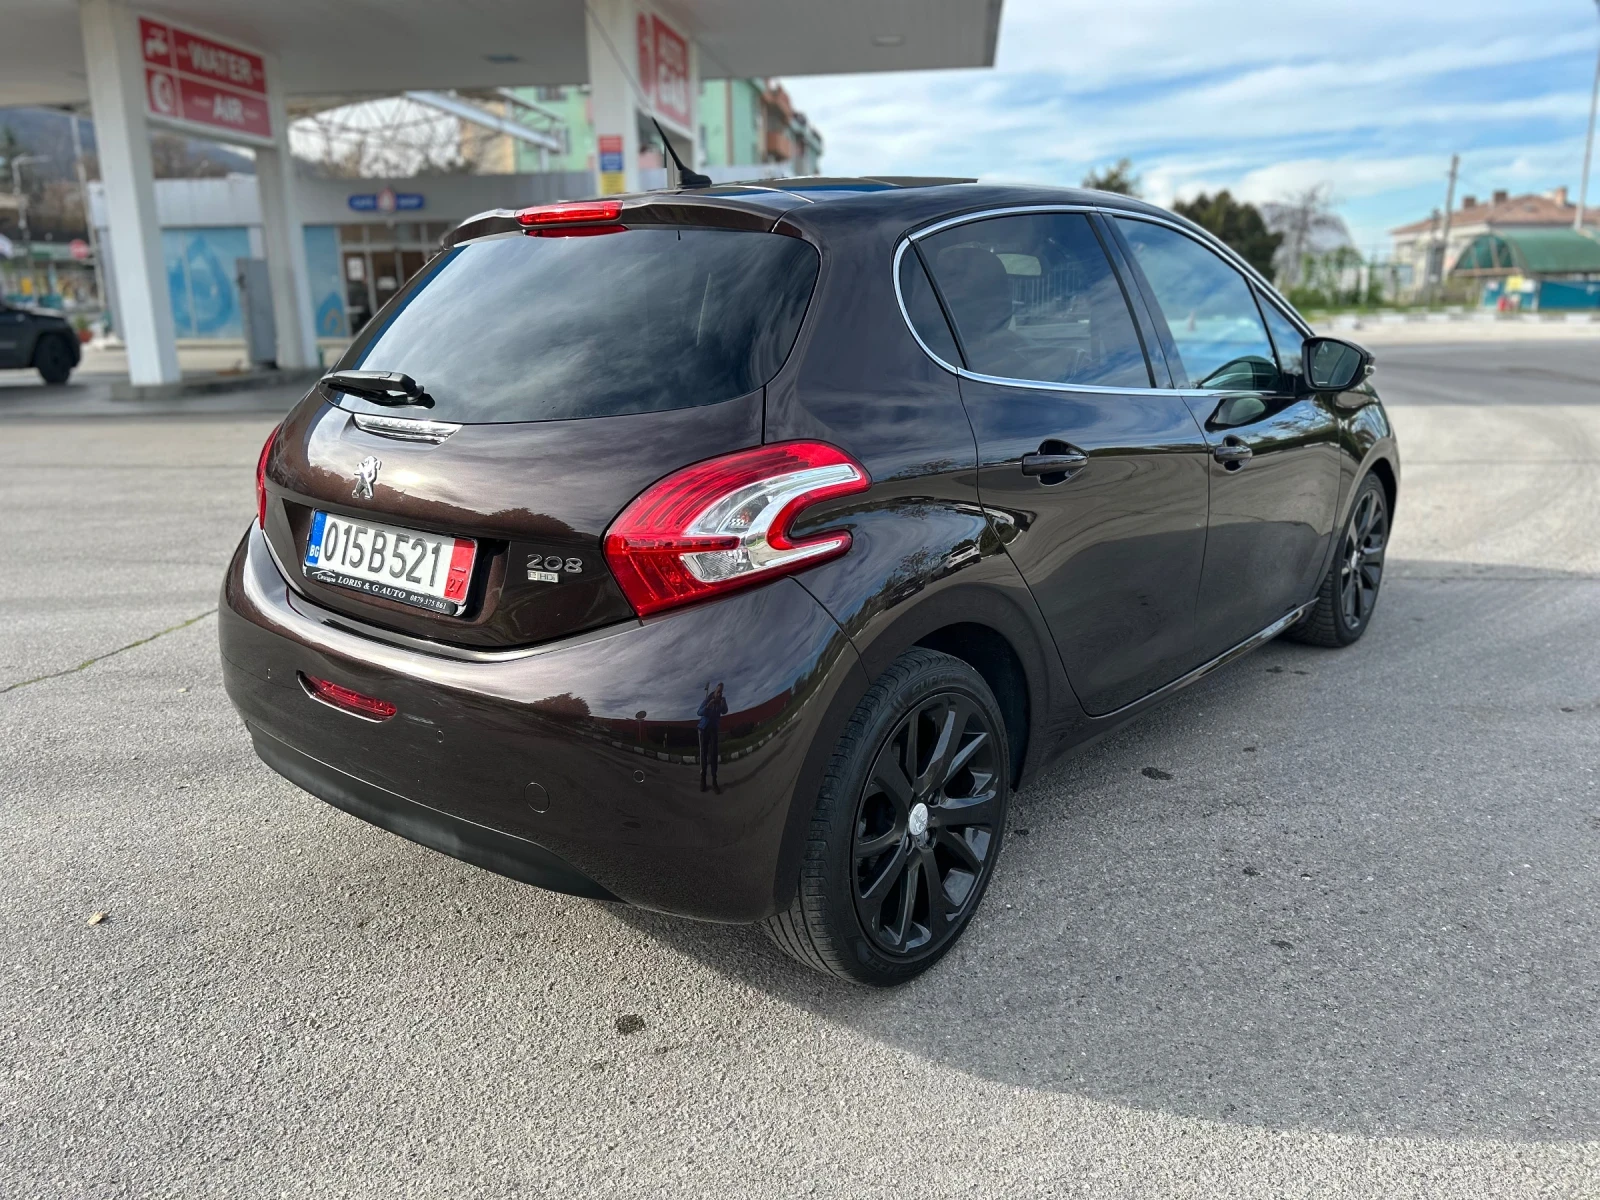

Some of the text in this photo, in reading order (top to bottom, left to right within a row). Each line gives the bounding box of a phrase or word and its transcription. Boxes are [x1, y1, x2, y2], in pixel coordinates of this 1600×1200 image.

[187, 40, 254, 85] WATER
[213, 93, 245, 123] AIR
[309, 545, 320, 558] BG
[324, 521, 442, 587] 015B521
[526, 554, 583, 573] 208
[337, 576, 363, 588] LORIS
[363, 582, 371, 591] &
[372, 584, 380, 593] G
[380, 586, 406, 599] AUTO
[447, 578, 465, 595] 27
